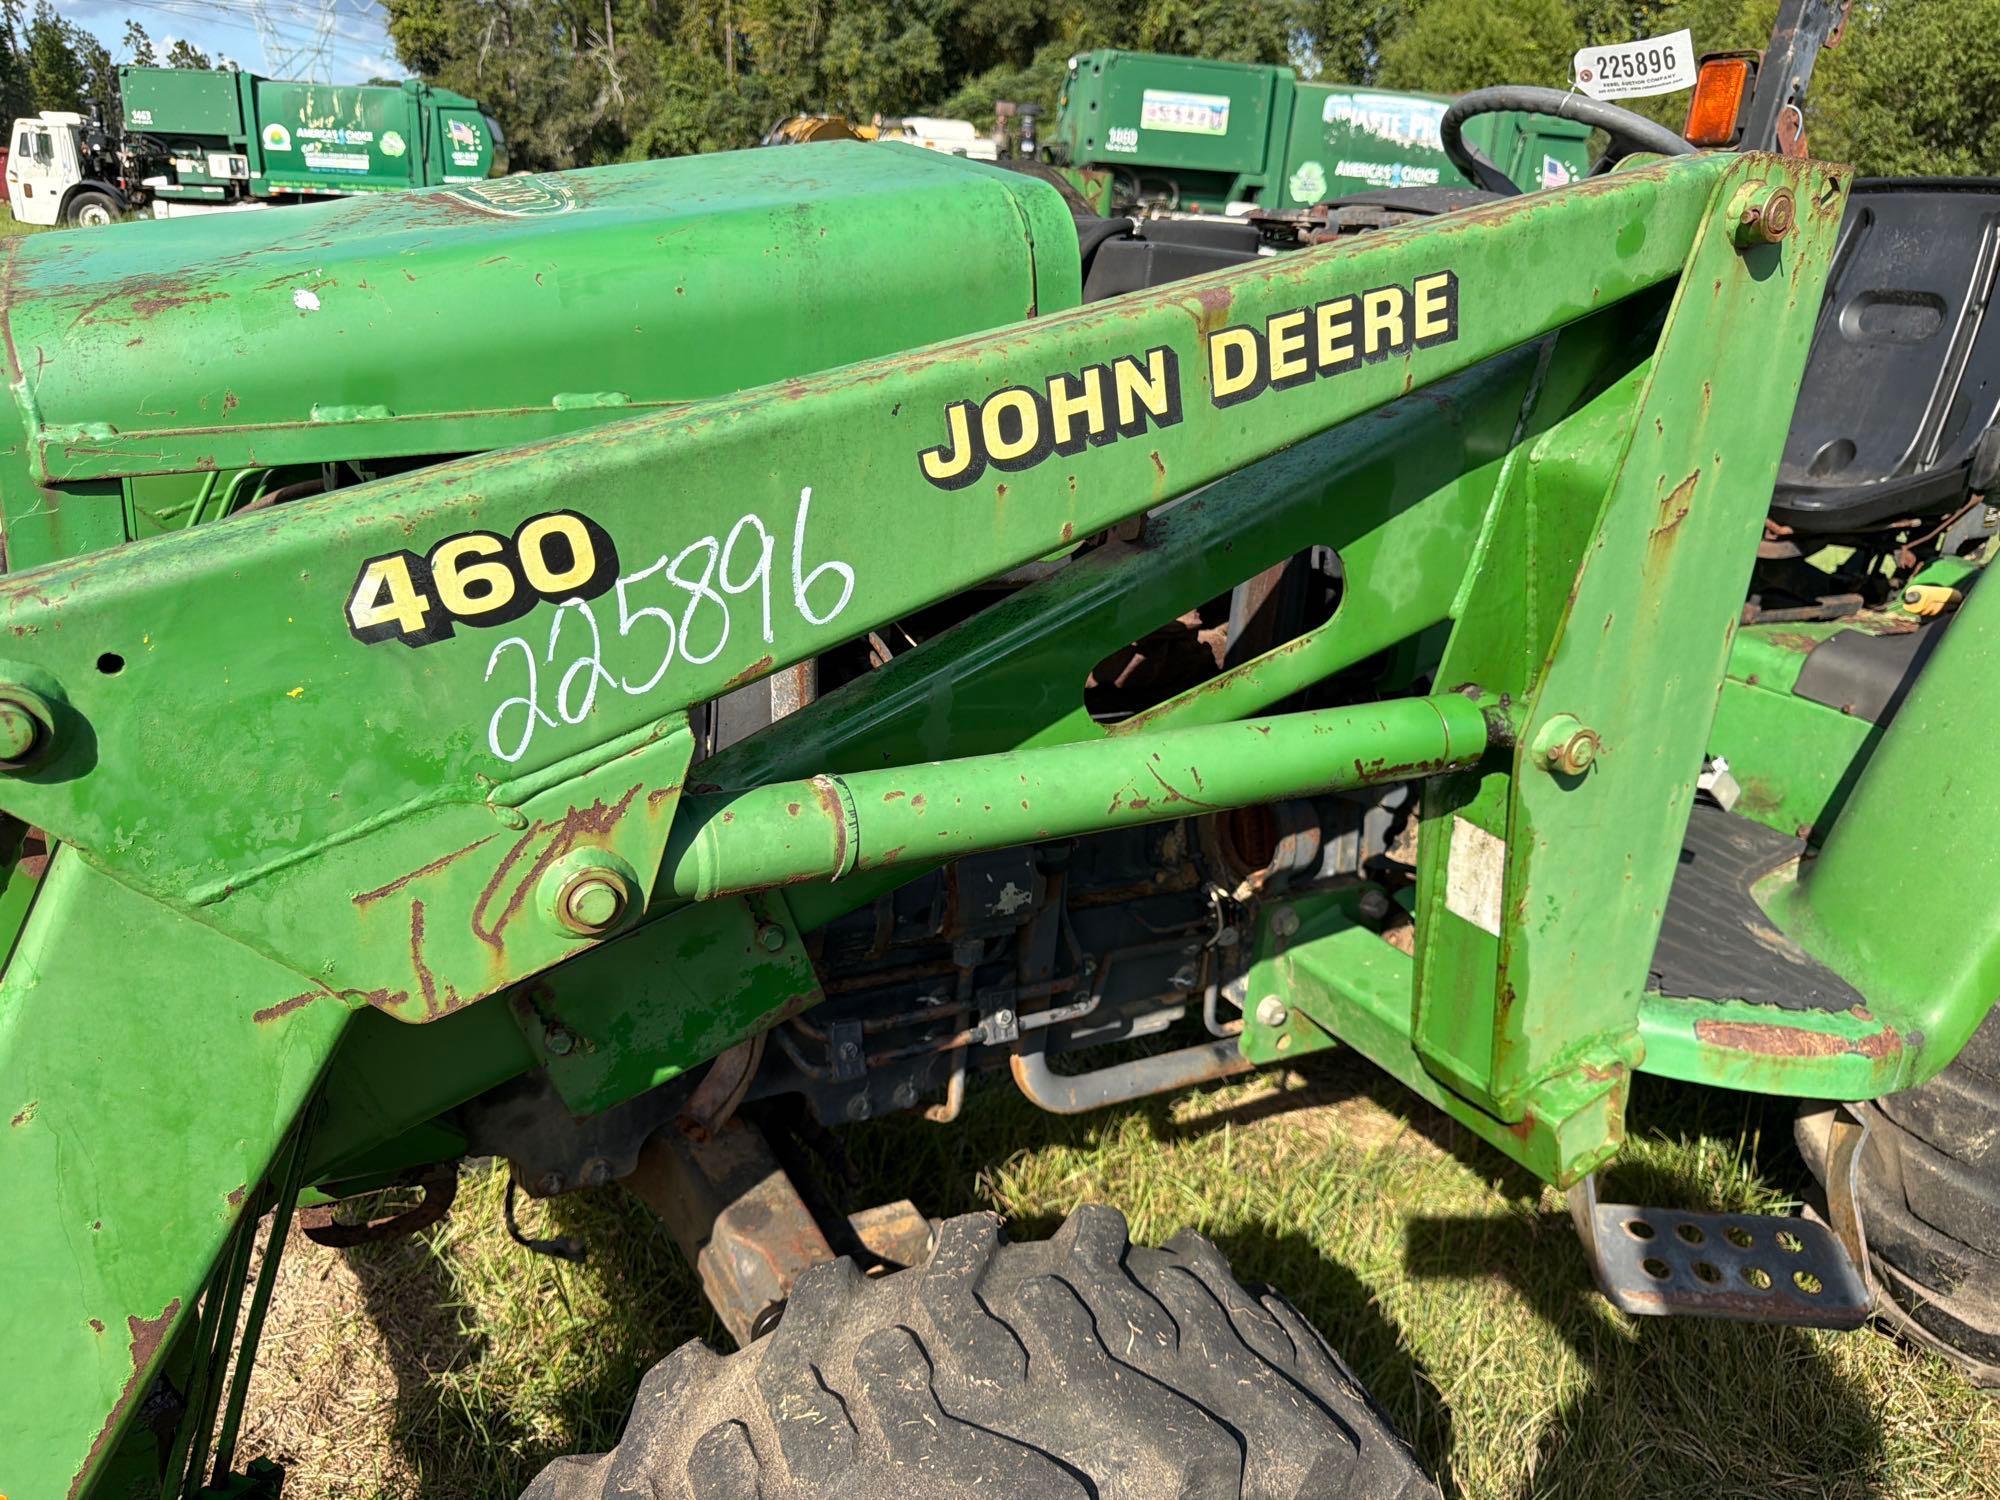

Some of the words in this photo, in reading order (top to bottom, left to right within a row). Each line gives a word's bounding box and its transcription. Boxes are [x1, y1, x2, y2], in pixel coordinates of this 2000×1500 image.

[1597, 46, 1676, 79] 225896
[1621, 79, 1645, 87] AUCTION
[1646, 73, 1676, 84] COMPANY
[1401, 165, 1440, 184] CHOICE
[920, 348, 1174, 484] JOHN
[1208, 271, 1454, 402] DEERE
[347, 511, 606, 640] 460
[484, 487, 855, 762] 225896
